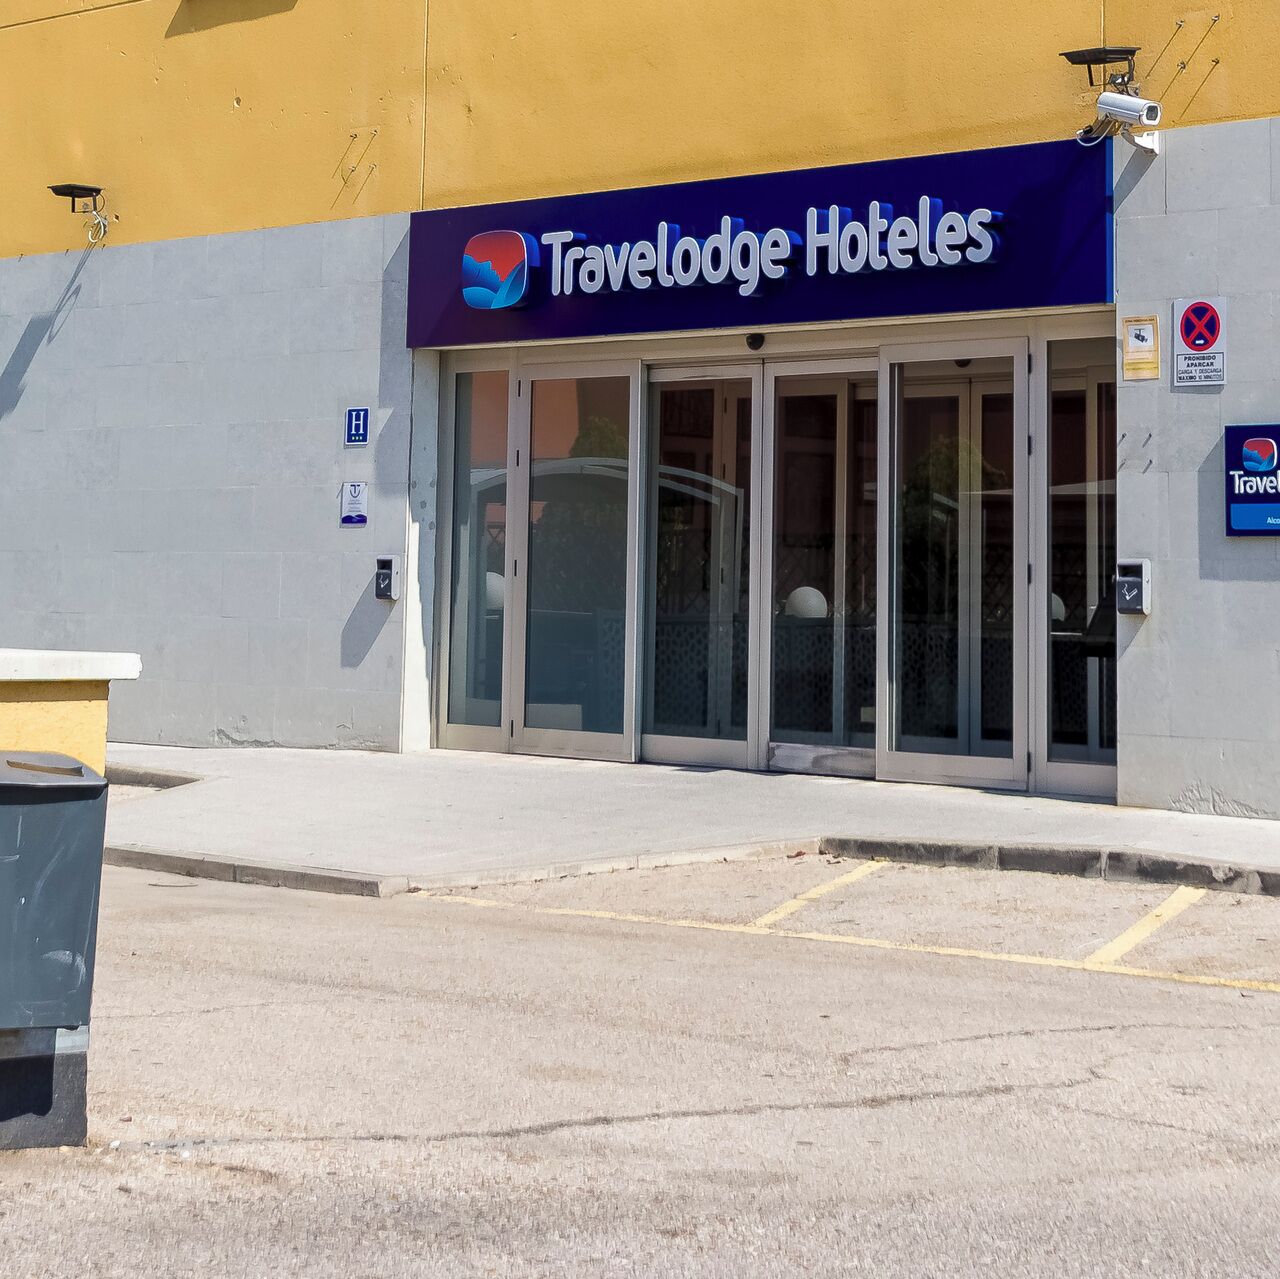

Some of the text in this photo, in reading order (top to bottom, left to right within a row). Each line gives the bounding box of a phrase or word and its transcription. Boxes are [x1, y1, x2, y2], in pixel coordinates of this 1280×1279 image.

[541, 195, 993, 296] Travelodge Hoteles
[351, 411, 365, 434] H
